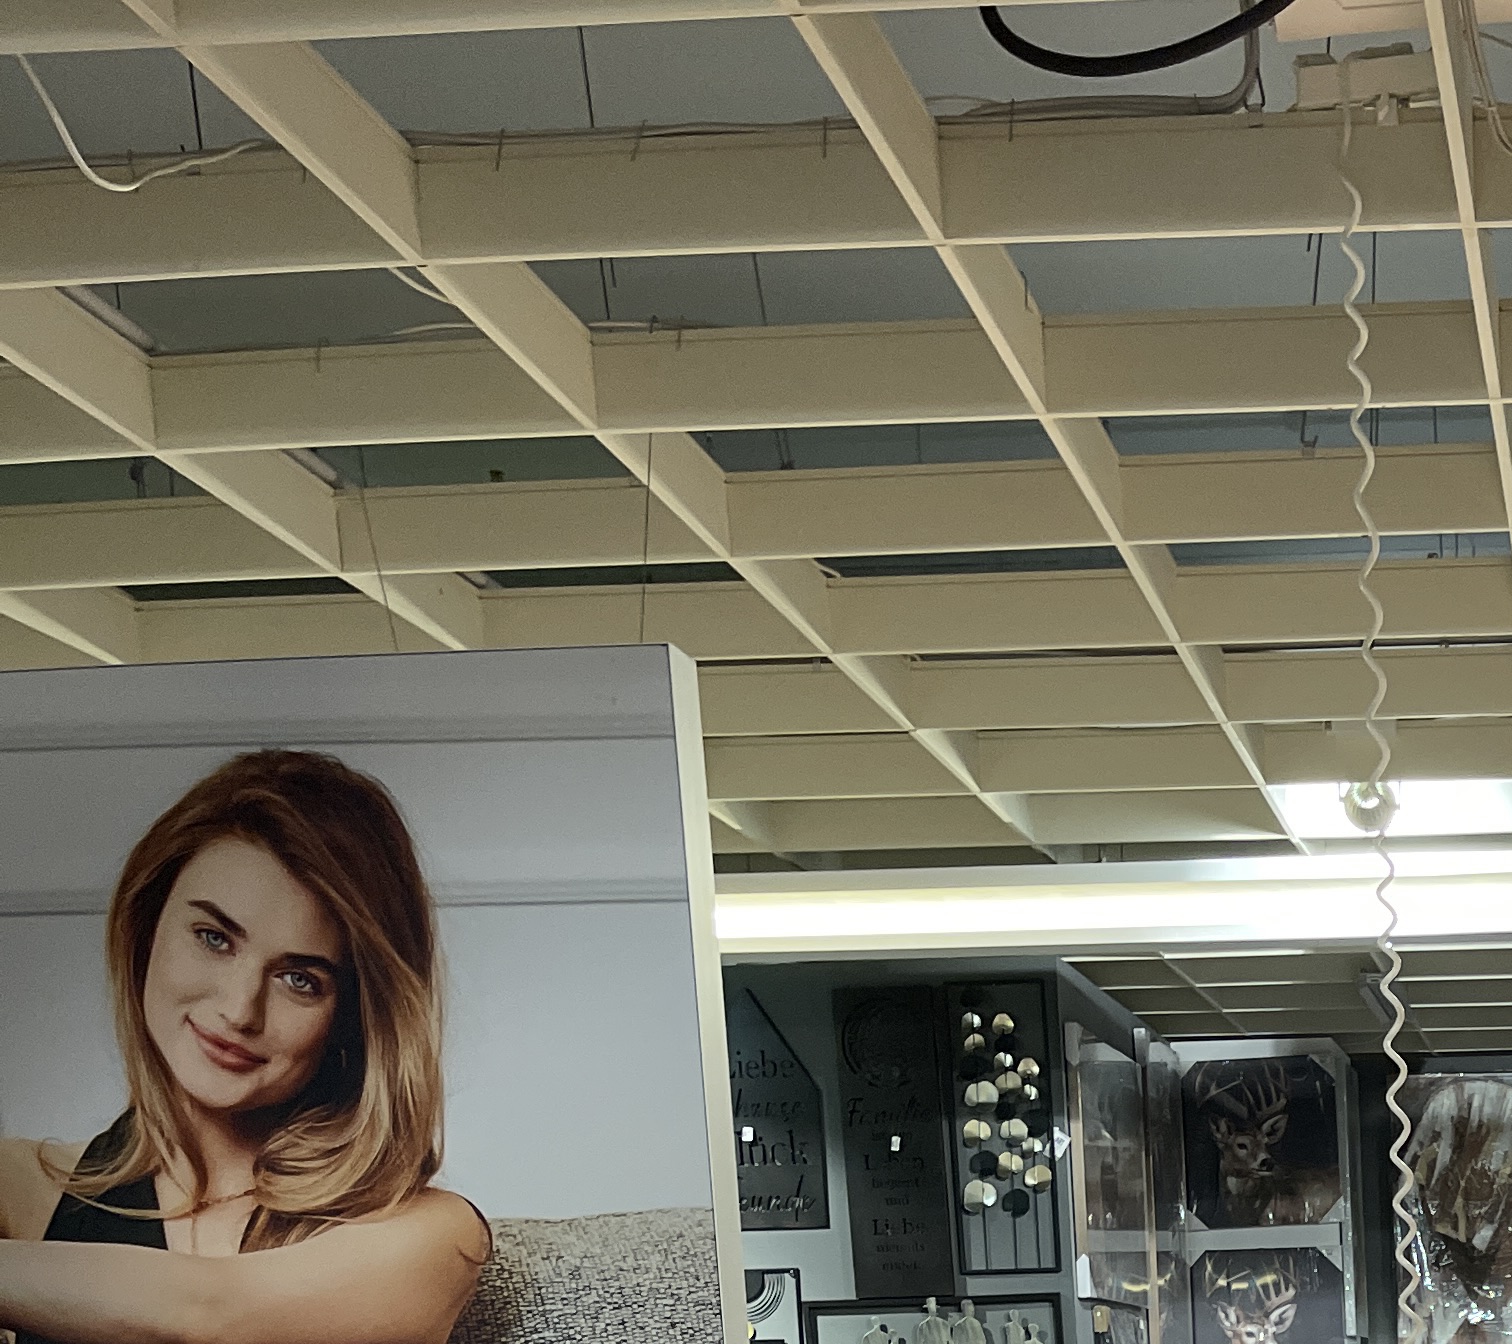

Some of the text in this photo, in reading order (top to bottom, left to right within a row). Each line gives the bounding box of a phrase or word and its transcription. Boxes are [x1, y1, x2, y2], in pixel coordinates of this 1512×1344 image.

[731, 1049, 795, 1079] iebe
[734, 1129, 810, 1166] lück
[872, 1218, 926, 1236] Libe
